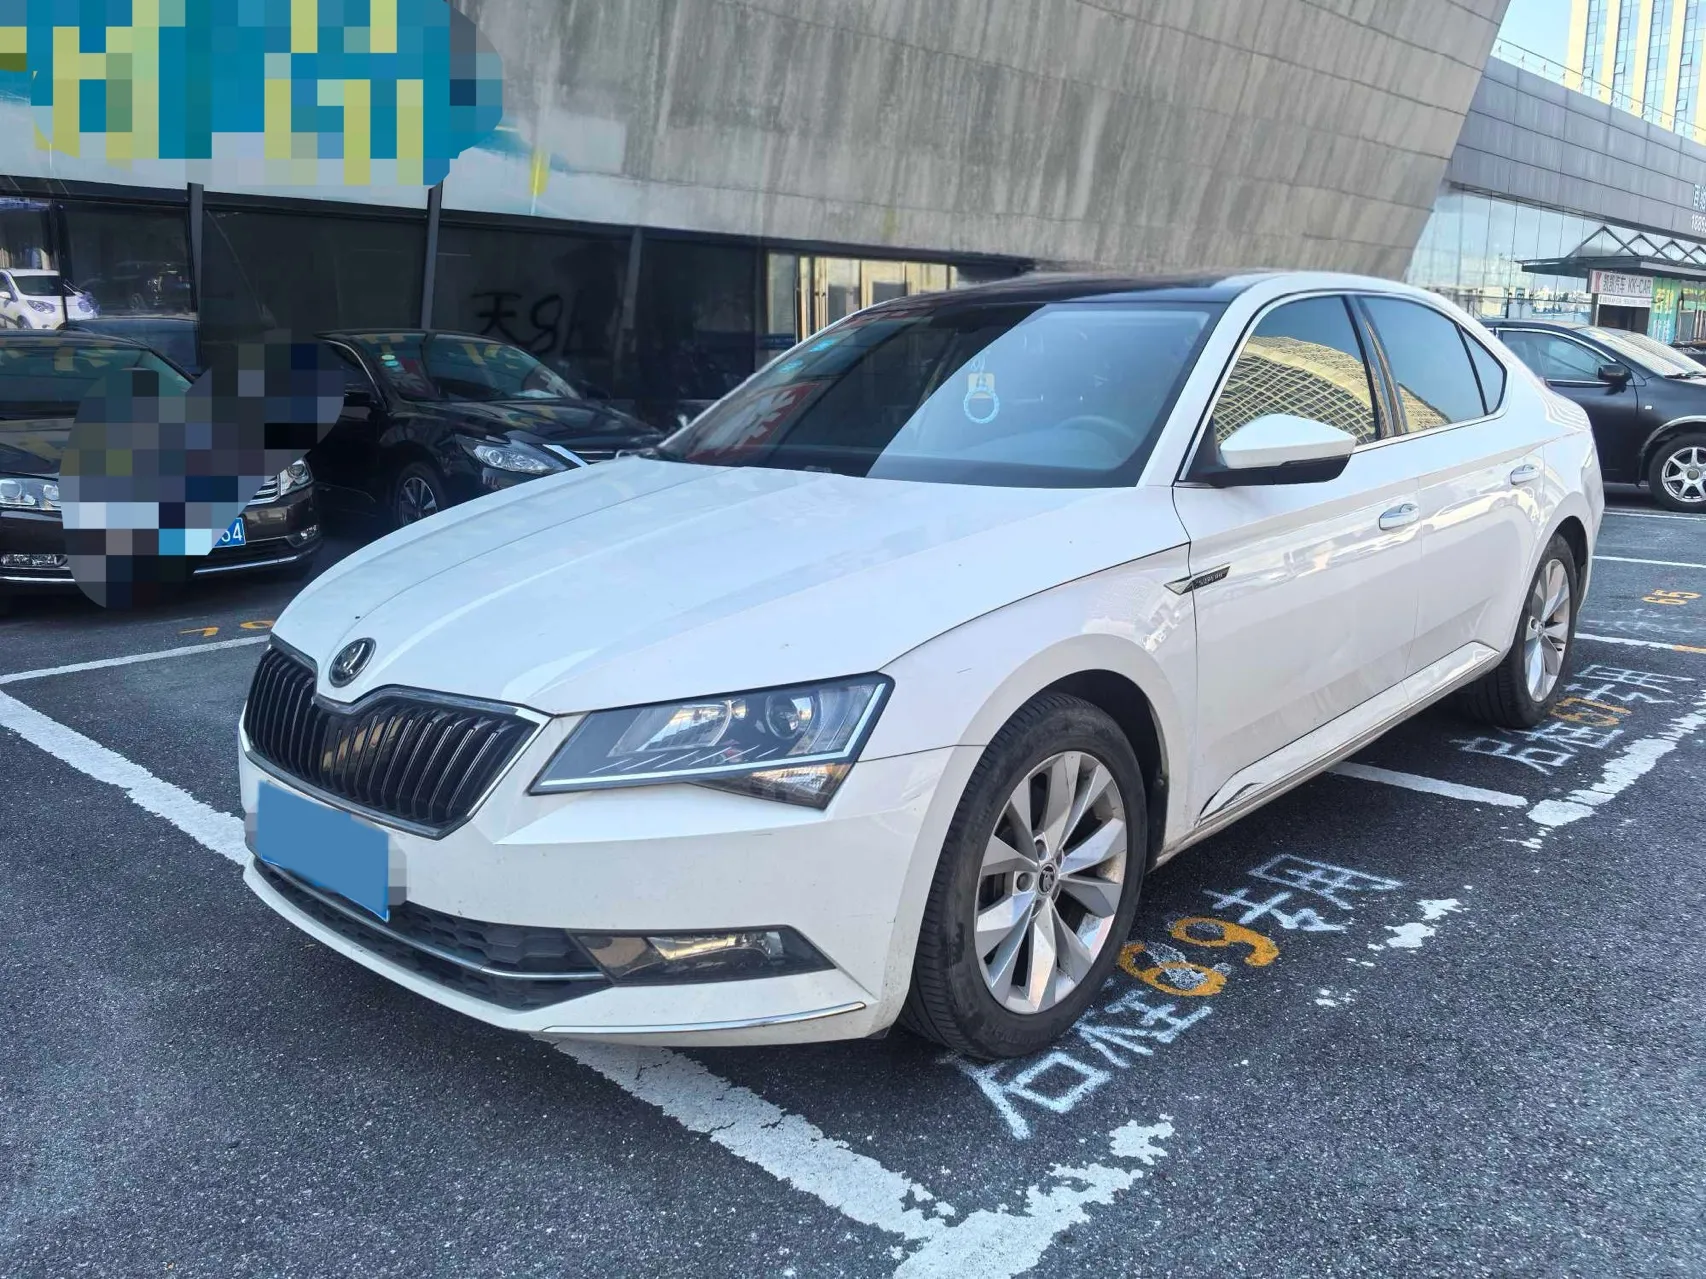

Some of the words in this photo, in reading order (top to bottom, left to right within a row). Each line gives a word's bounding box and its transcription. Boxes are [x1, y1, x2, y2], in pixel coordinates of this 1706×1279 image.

[1641, 589, 1702, 605] 65
[1202, 853, 1404, 932] 专用
[1119, 916, 1280, 997] 69
